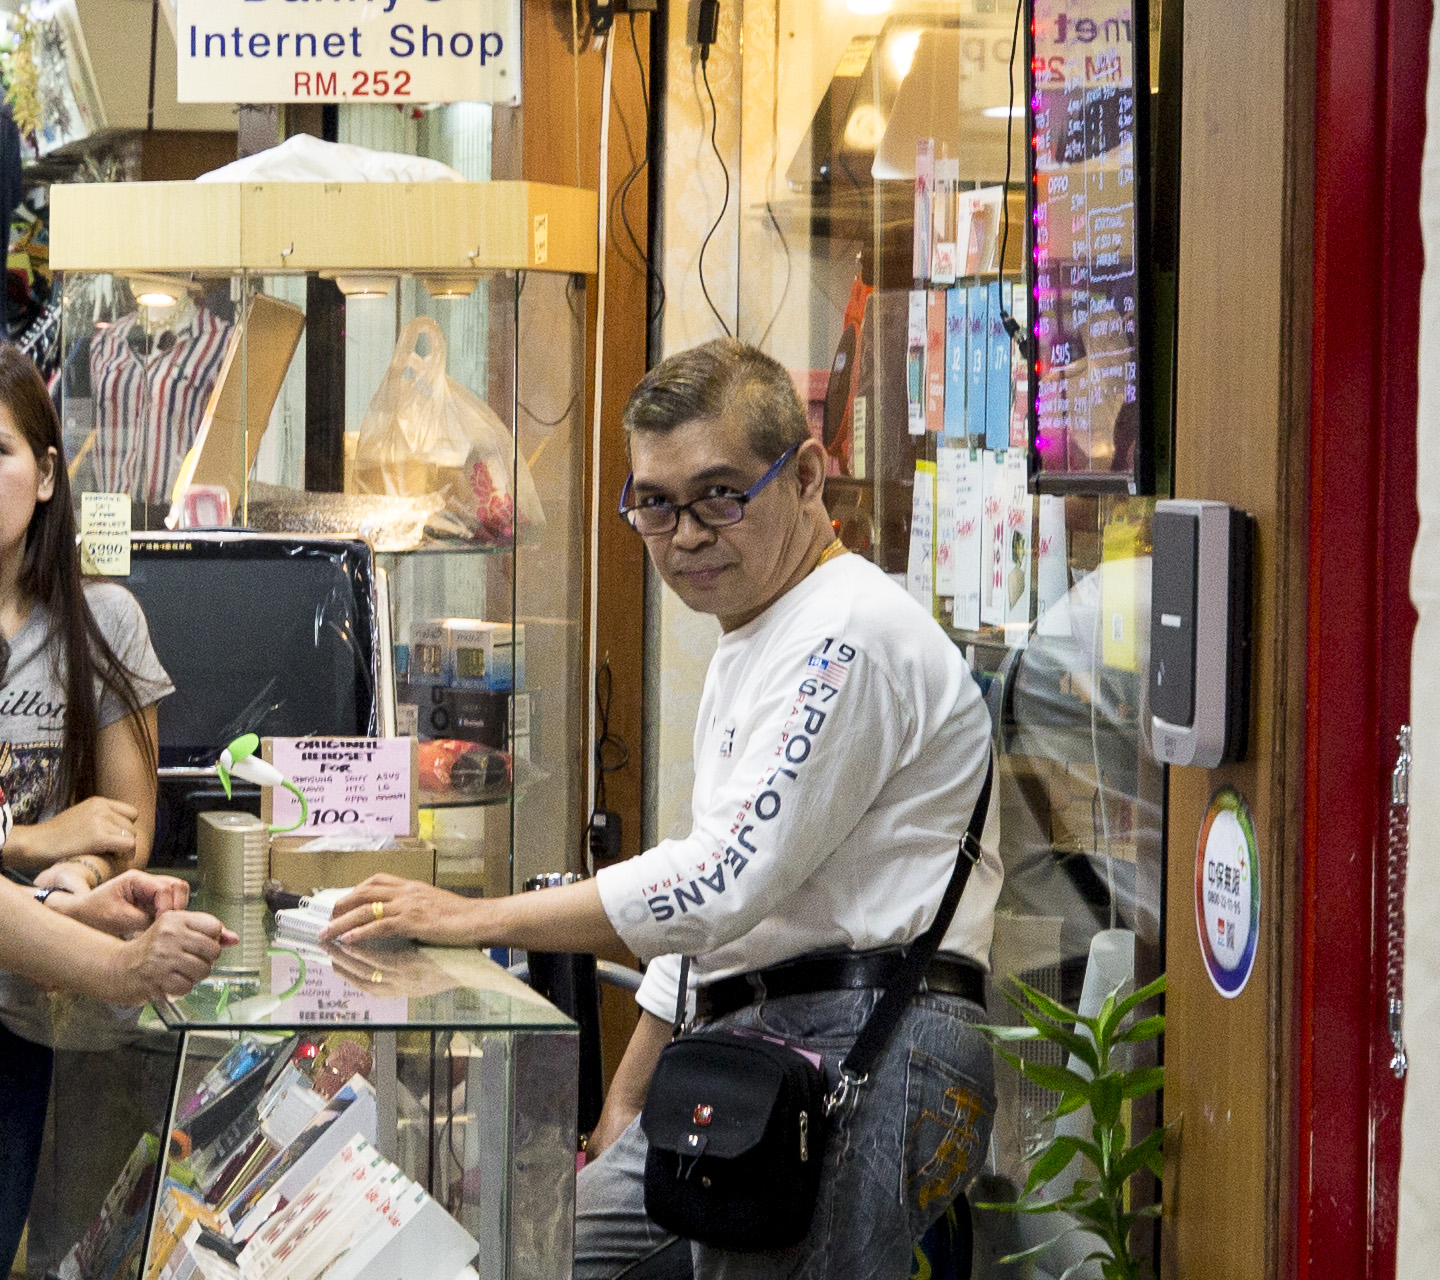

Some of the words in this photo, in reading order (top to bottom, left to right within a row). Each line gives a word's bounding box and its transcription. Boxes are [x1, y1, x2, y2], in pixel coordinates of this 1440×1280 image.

[189, 24, 362, 58] Internet
[389, 23, 504, 67] Shop
[293, 70, 412, 99] RM.252
[821, 636, 857, 664] 19
[798, 678, 839, 704] 67
[753, 704, 827, 822] POLO
[647, 825, 759, 923] JEANS
